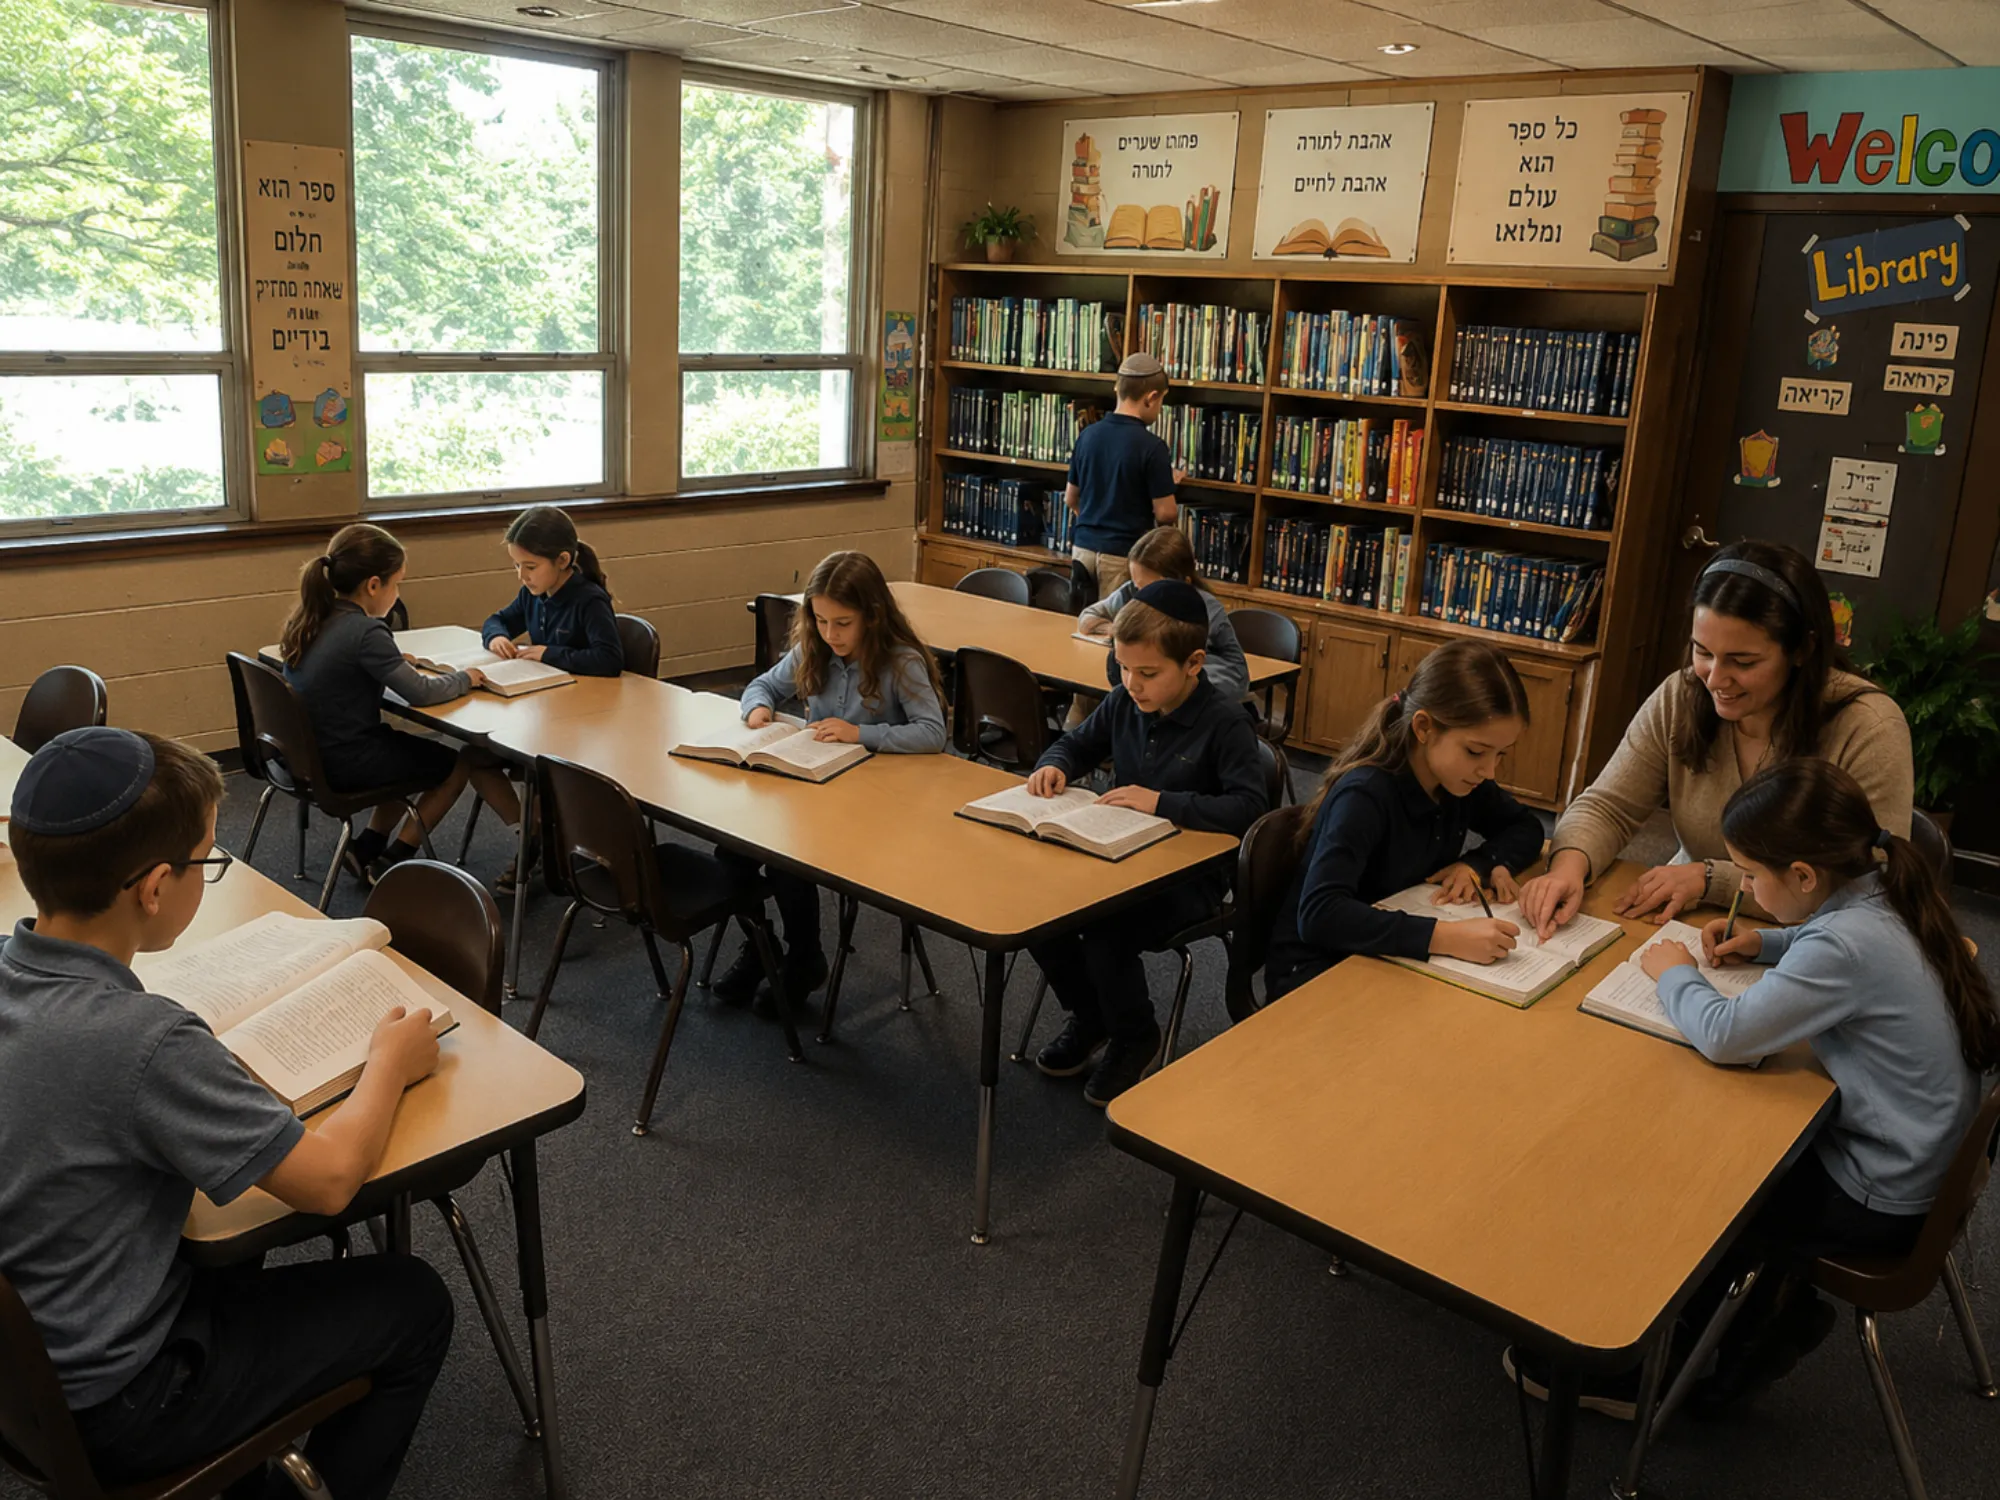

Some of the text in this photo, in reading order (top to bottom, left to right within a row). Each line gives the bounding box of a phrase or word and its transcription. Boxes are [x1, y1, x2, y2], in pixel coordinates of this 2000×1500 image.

[1555, 115, 1578, 139] כל
[1118, 135, 1161, 151] שערים
[1296, 130, 1392, 151] אהבת לתורה
[1131, 159, 1173, 179] לתורה
[1519, 155, 1555, 173] הוא
[258, 178, 336, 203] ספר הוא
[1294, 171, 1388, 193] אהבת לחיים
[1508, 183, 1557, 209] עולם
[274, 224, 322, 253] חלום
[1495, 217, 1562, 244] ומלואו
[1813, 242, 1959, 301] Library
[272, 328, 331, 351] בידיים
[1784, 385, 1844, 407] קריאה
